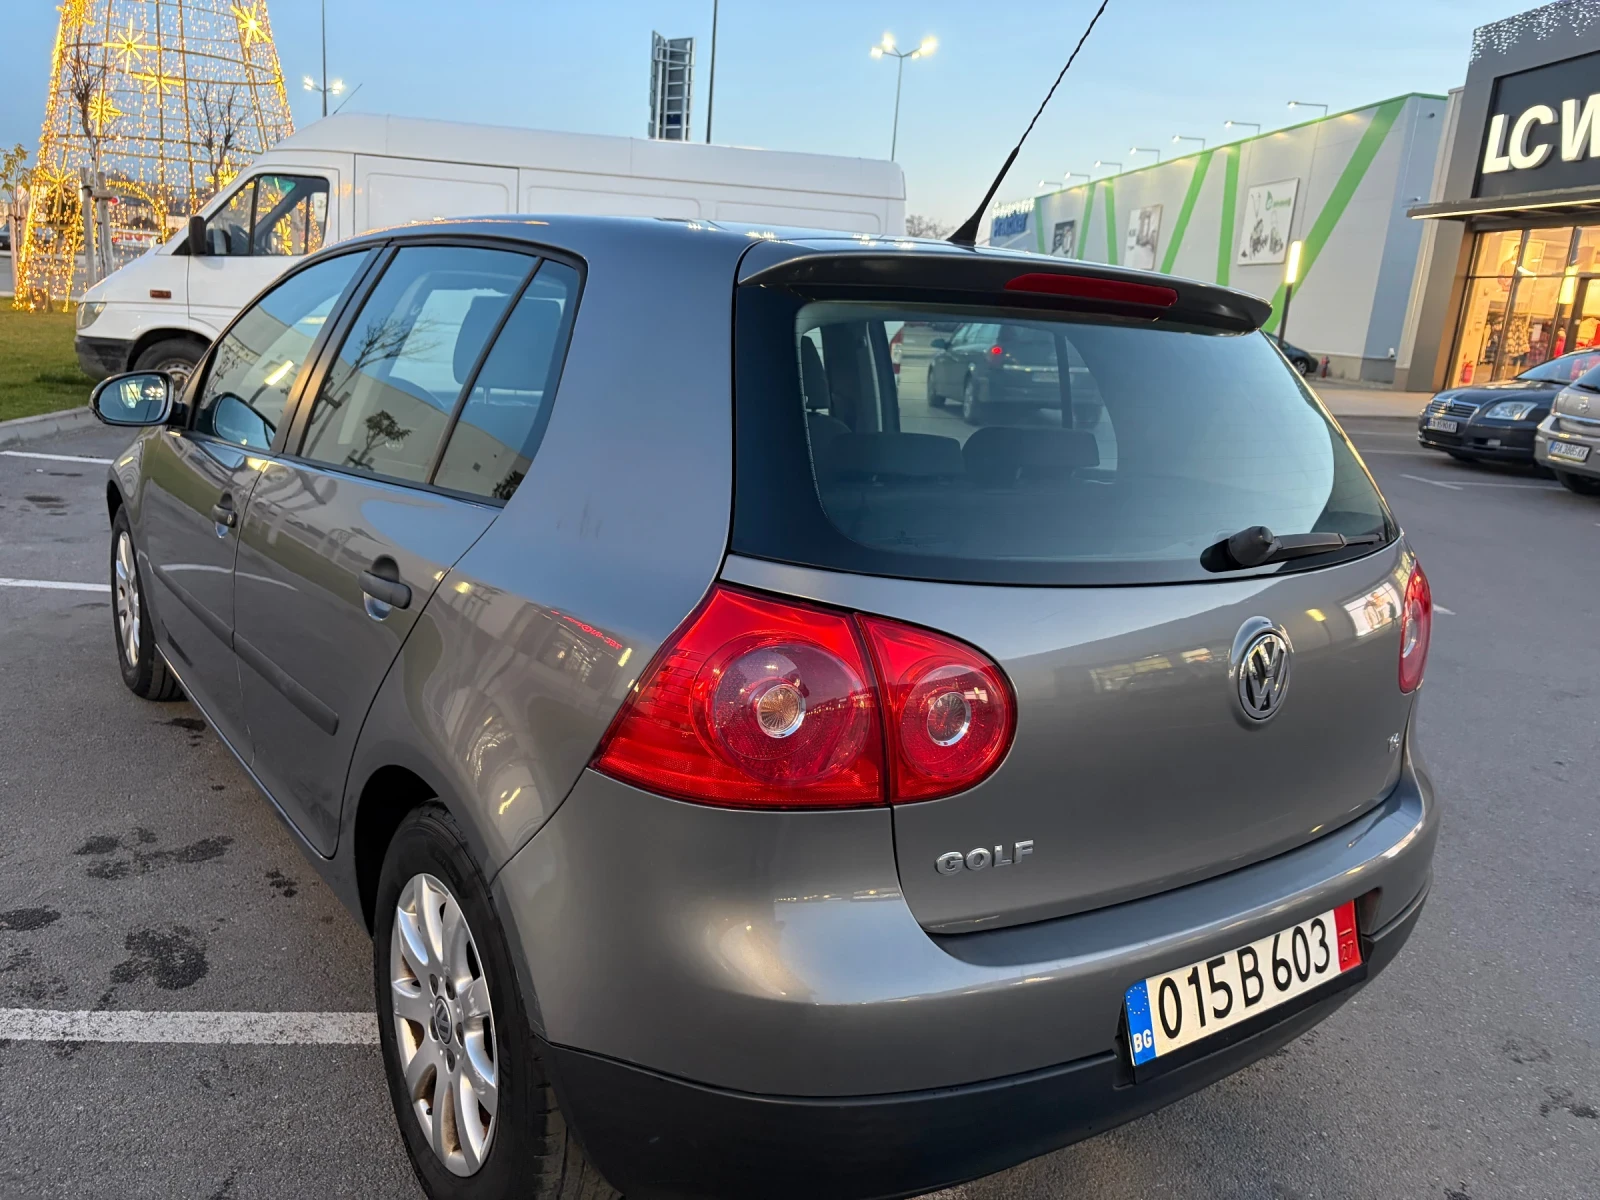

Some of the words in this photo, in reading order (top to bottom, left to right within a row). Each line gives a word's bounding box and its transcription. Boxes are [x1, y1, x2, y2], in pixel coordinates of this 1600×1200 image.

[1482, 105, 1559, 174] LC
[935, 840, 1034, 876] GOLF
[1132, 1029, 1154, 1054] BG
